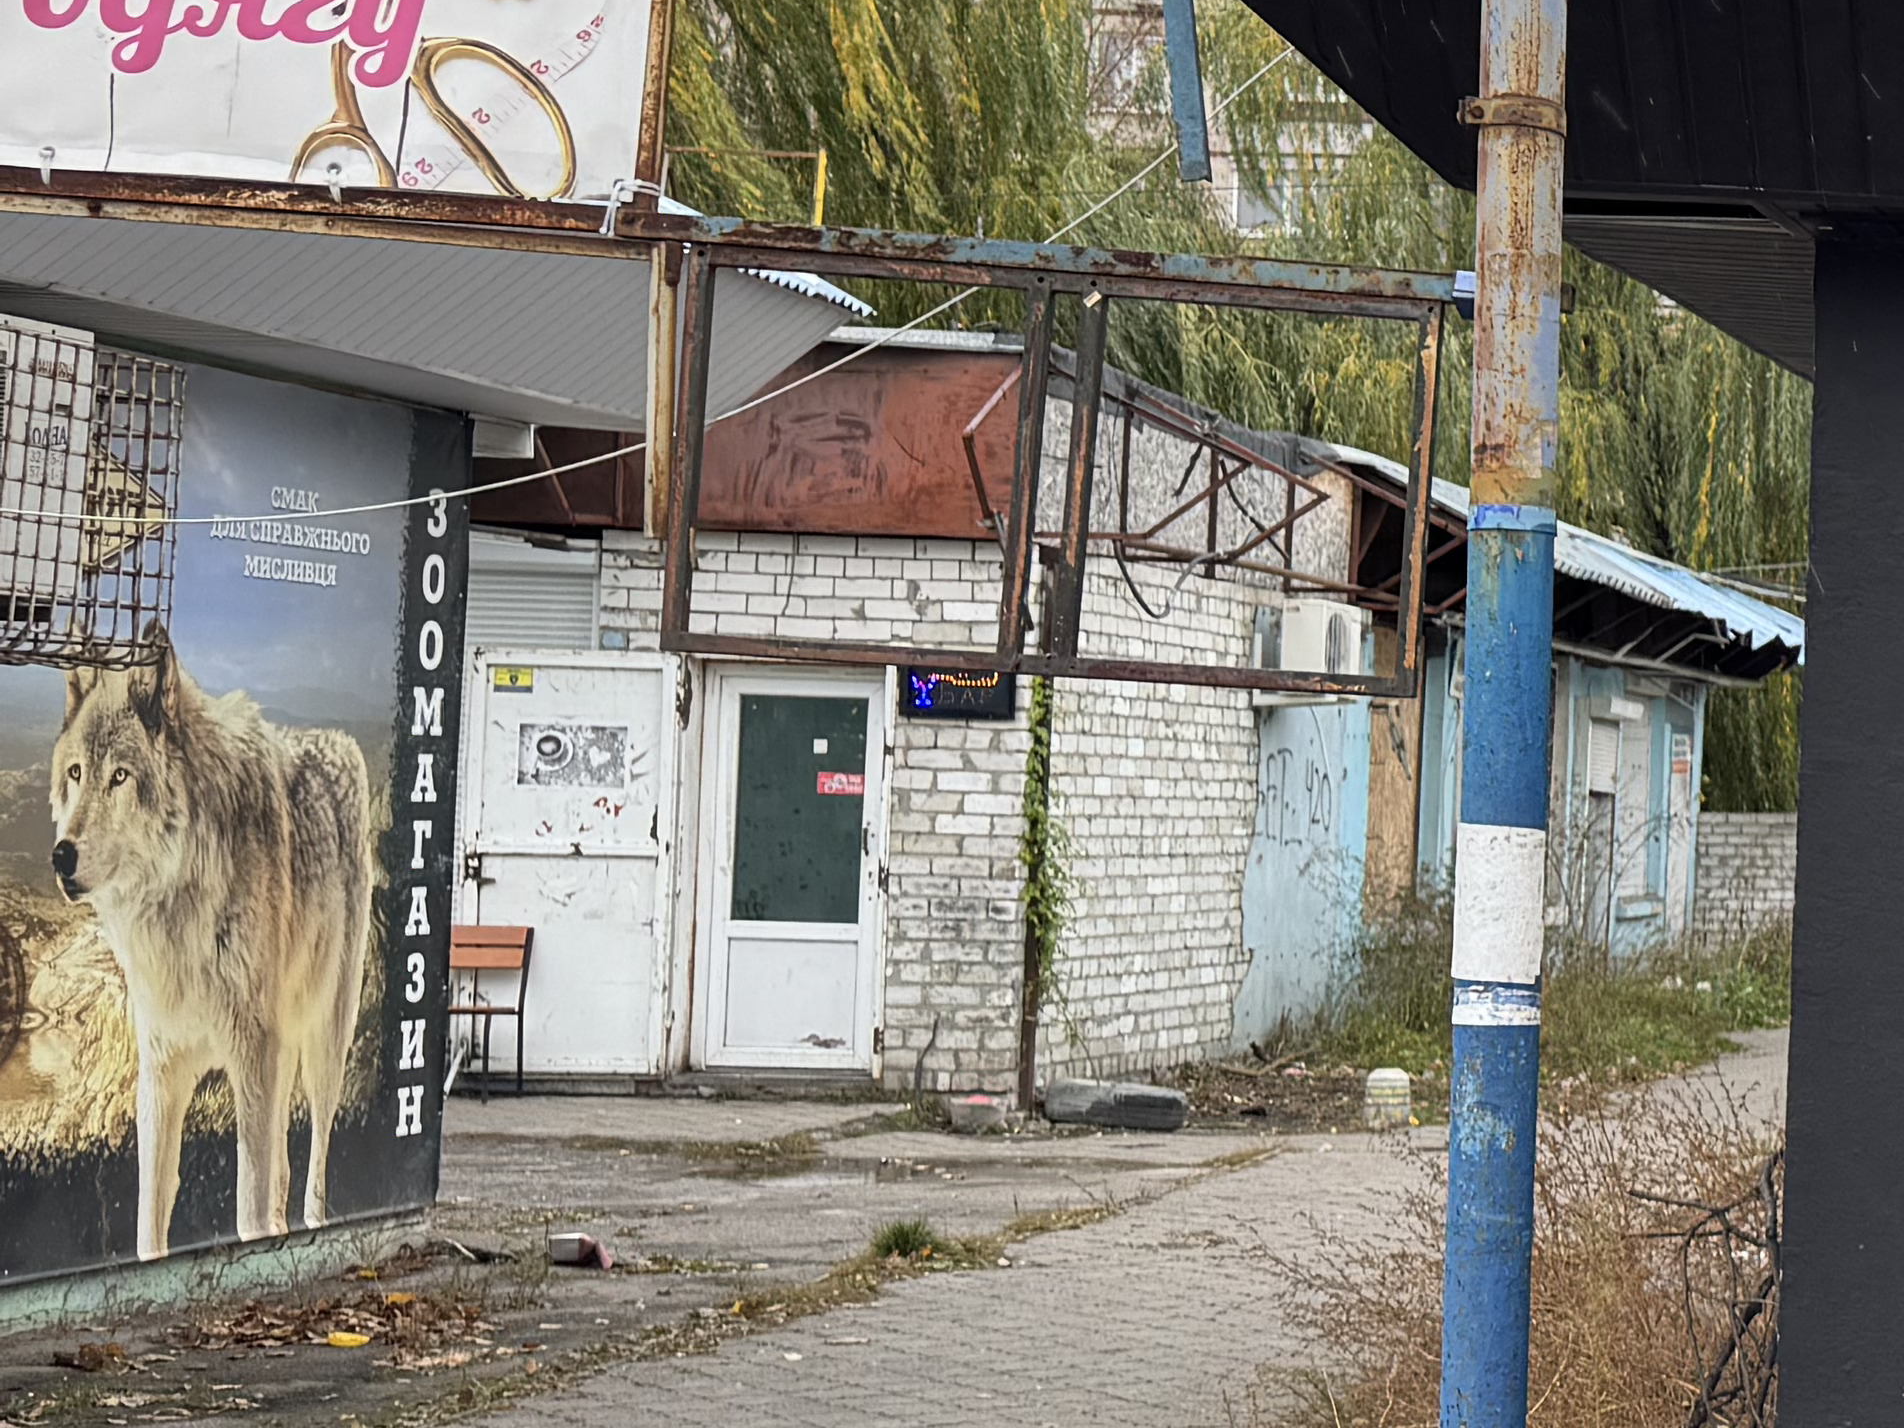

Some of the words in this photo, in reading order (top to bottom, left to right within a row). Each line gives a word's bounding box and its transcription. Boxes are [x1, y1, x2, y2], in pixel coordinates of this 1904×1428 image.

[271, 485, 321, 514] СМАК
[209, 514, 247, 540] ДЛЯ
[250, 520, 371, 556] СПРАВЖНЬОГО
[244, 554, 338, 588] МИСЛИВЦЯ
[395, 488, 449, 1137] ЗООМАГАЗИН
